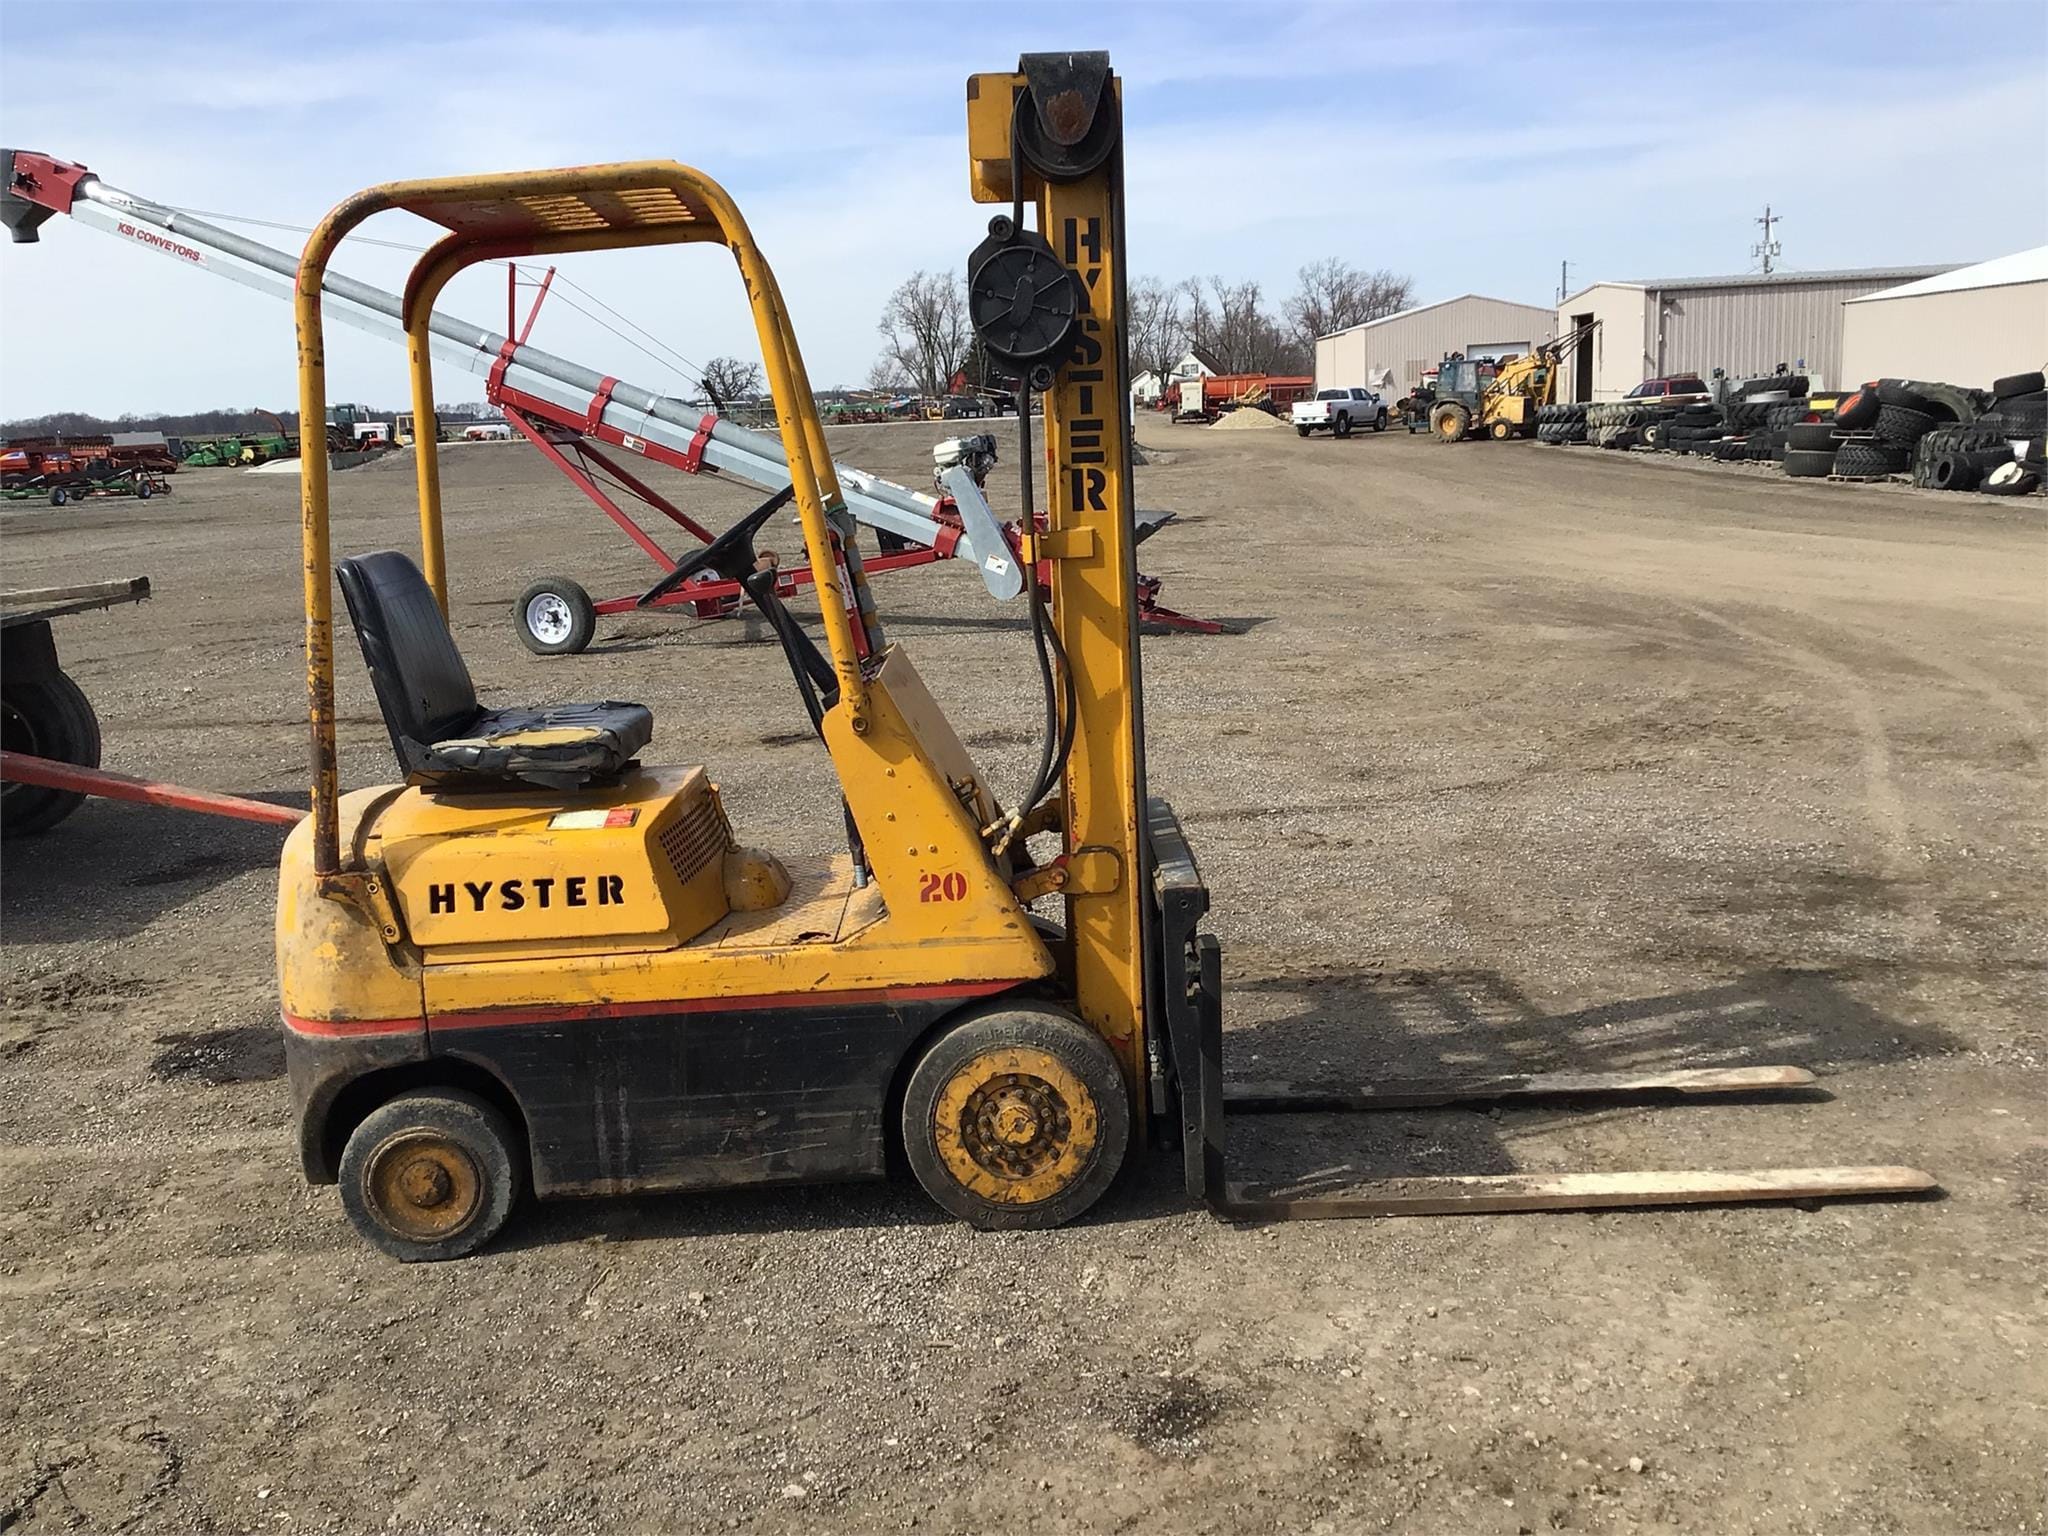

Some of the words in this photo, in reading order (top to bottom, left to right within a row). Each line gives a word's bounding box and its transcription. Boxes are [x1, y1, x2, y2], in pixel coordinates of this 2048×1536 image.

[117, 222, 136, 237] KSI
[136, 229, 201, 262] CONVEYORS
[1065, 217, 1108, 512] HYSTER
[429, 874, 625, 914] HYSTER
[919, 871, 967, 903] 20
